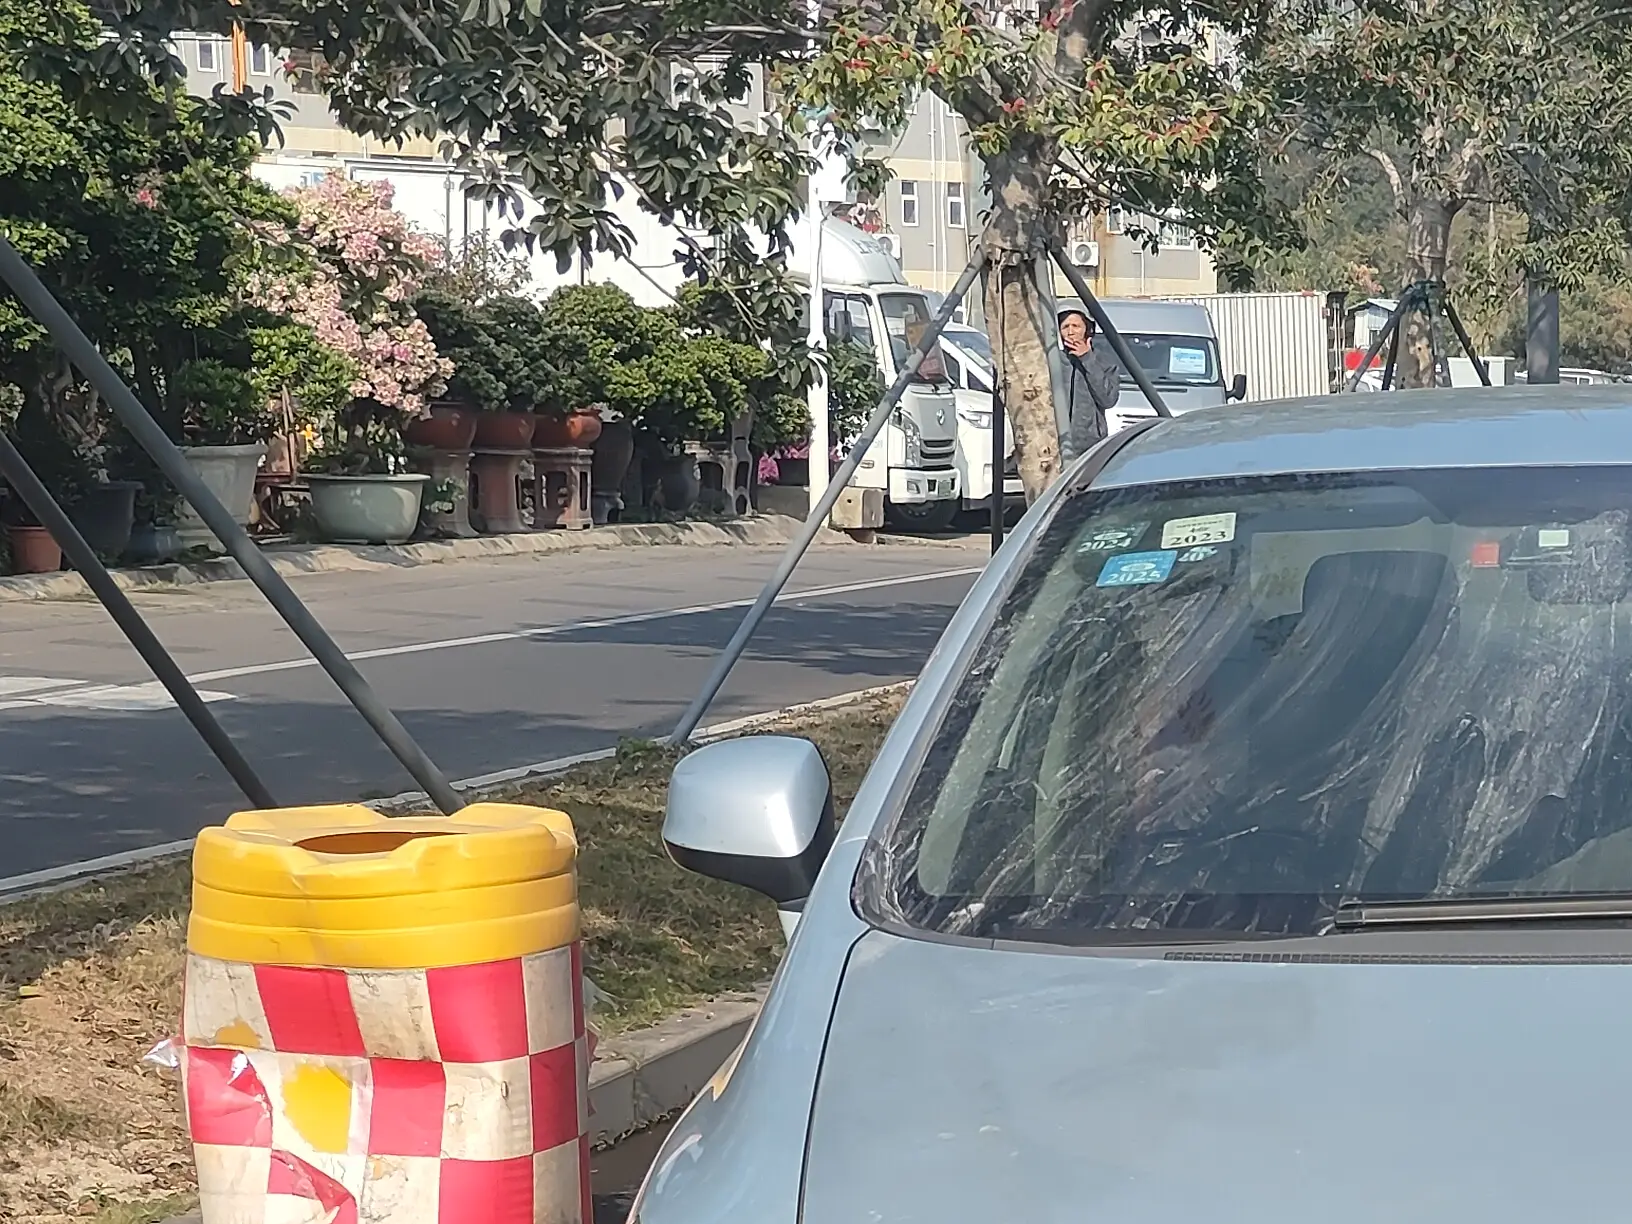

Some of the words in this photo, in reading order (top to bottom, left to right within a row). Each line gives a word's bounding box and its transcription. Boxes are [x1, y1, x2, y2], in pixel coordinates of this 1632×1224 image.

[1077, 537, 1132, 553] 2024
[1170, 531, 1226, 546] 2023
[1105, 570, 1161, 584] 2025
